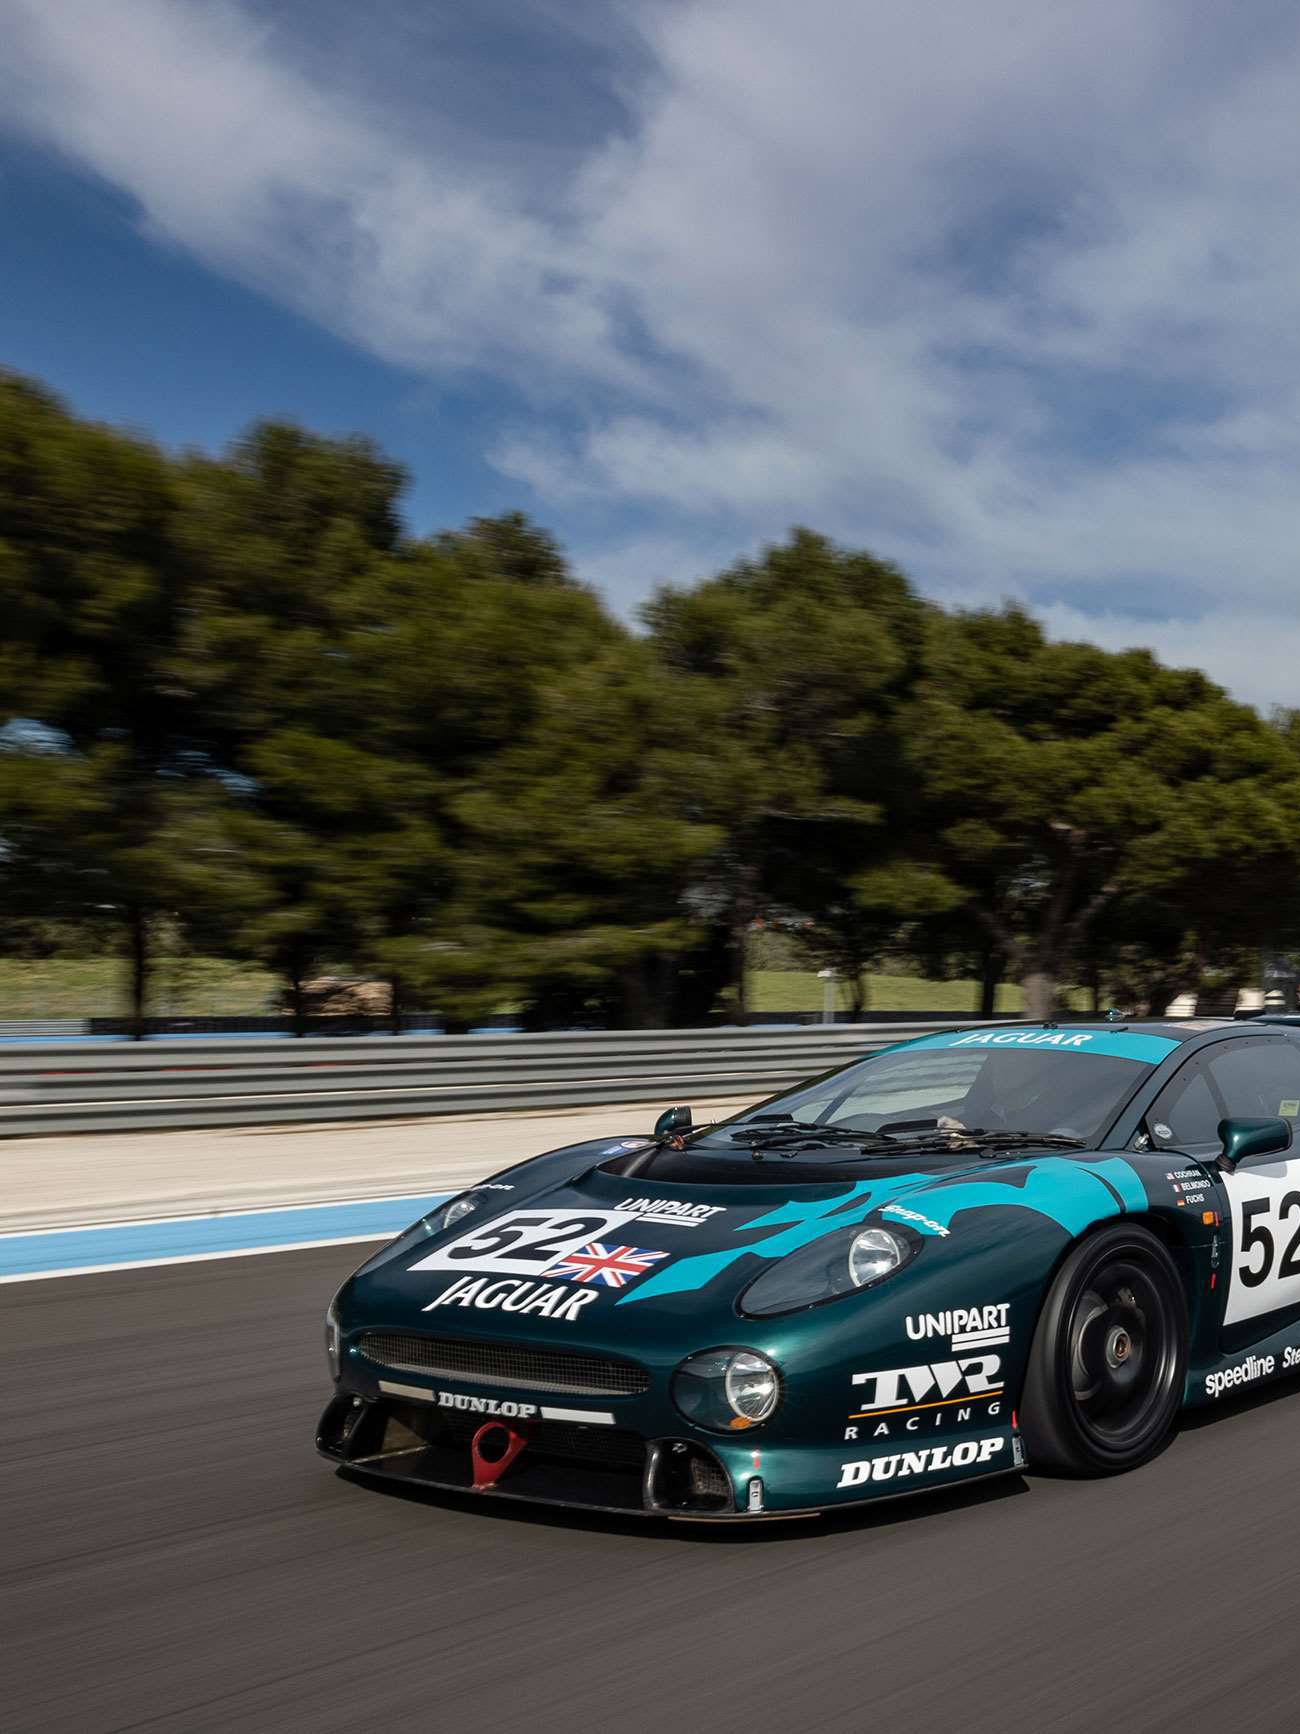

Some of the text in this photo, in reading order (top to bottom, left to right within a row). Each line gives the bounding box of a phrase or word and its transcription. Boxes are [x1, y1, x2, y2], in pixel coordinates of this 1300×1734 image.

[950, 1032, 1093, 1046] JAGUAR
[1180, 1179, 1211, 1191] BELMONDO
[1185, 1193, 1205, 1204] FUCHS
[615, 1198, 727, 1219] UNIPART
[446, 1217, 608, 1262] 52
[422, 1276, 600, 1321] JAGUAR
[905, 1303, 1010, 1340] UNIPART
[852, 1354, 1004, 1411] TWR
[1205, 1354, 1275, 1398] speedline
[438, 1391, 538, 1419] DUNLOP
[844, 1402, 1001, 1441] RACING
[836, 1437, 1005, 1489] DUNLOP
